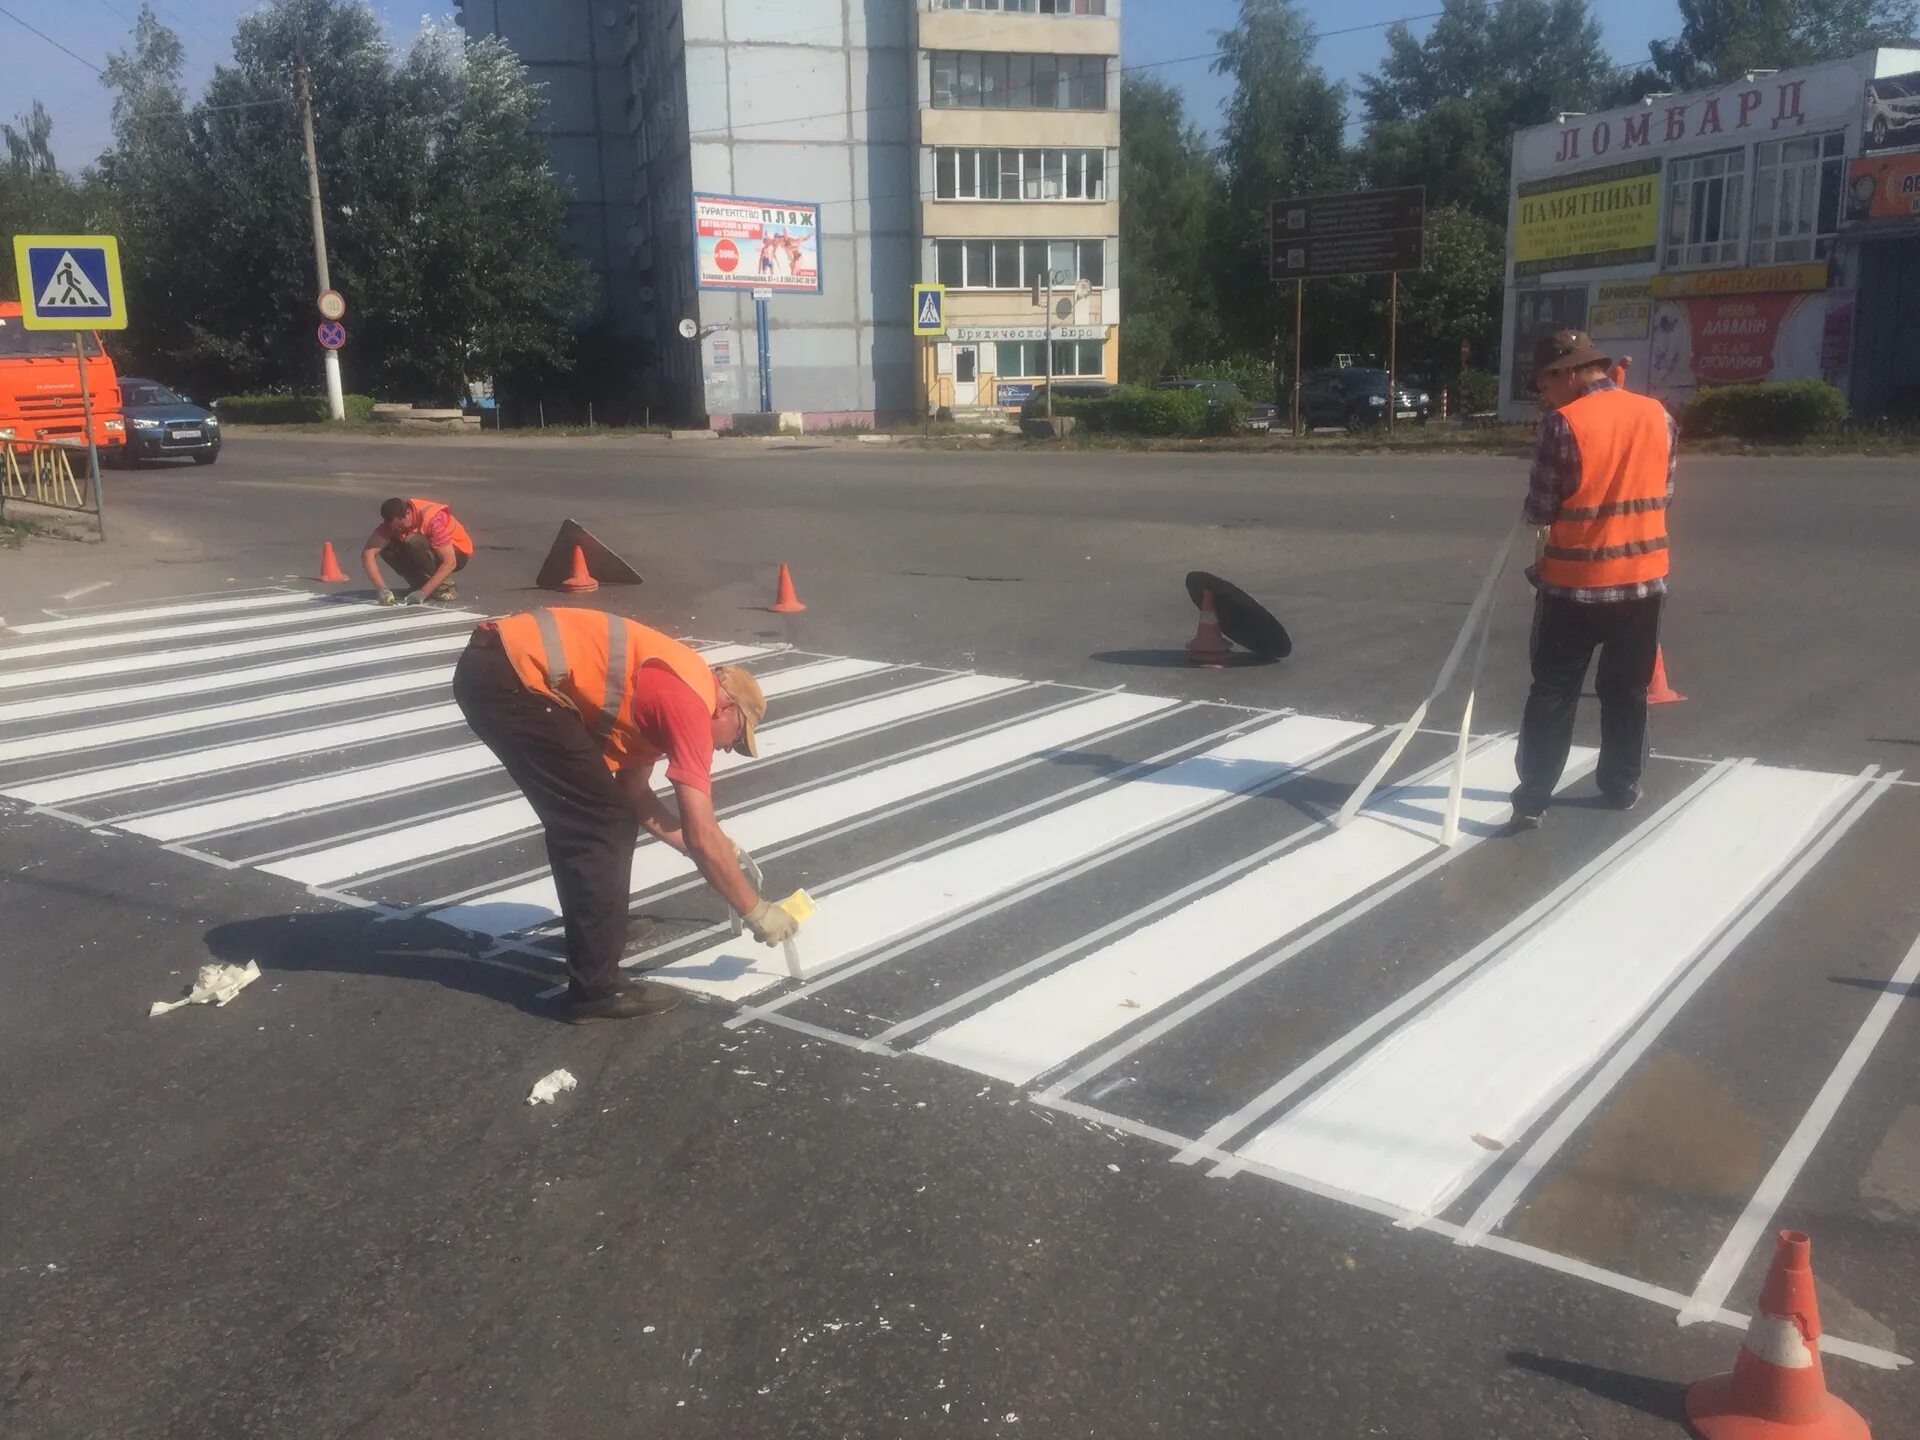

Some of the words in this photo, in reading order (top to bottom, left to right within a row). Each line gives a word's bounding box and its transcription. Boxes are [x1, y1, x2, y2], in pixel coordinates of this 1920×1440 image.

[1554, 79, 1807, 162] ЛОМБАРД
[1521, 182, 1653, 224] ПАМЯТНИКИ
[700, 206, 759, 219] ТУРАГЕНТСТВО
[761, 209, 814, 227] ПЛЯЖ
[1695, 269, 1803, 292] САНТЕХНИКА
[1061, 327, 1093, 338] Бюро
